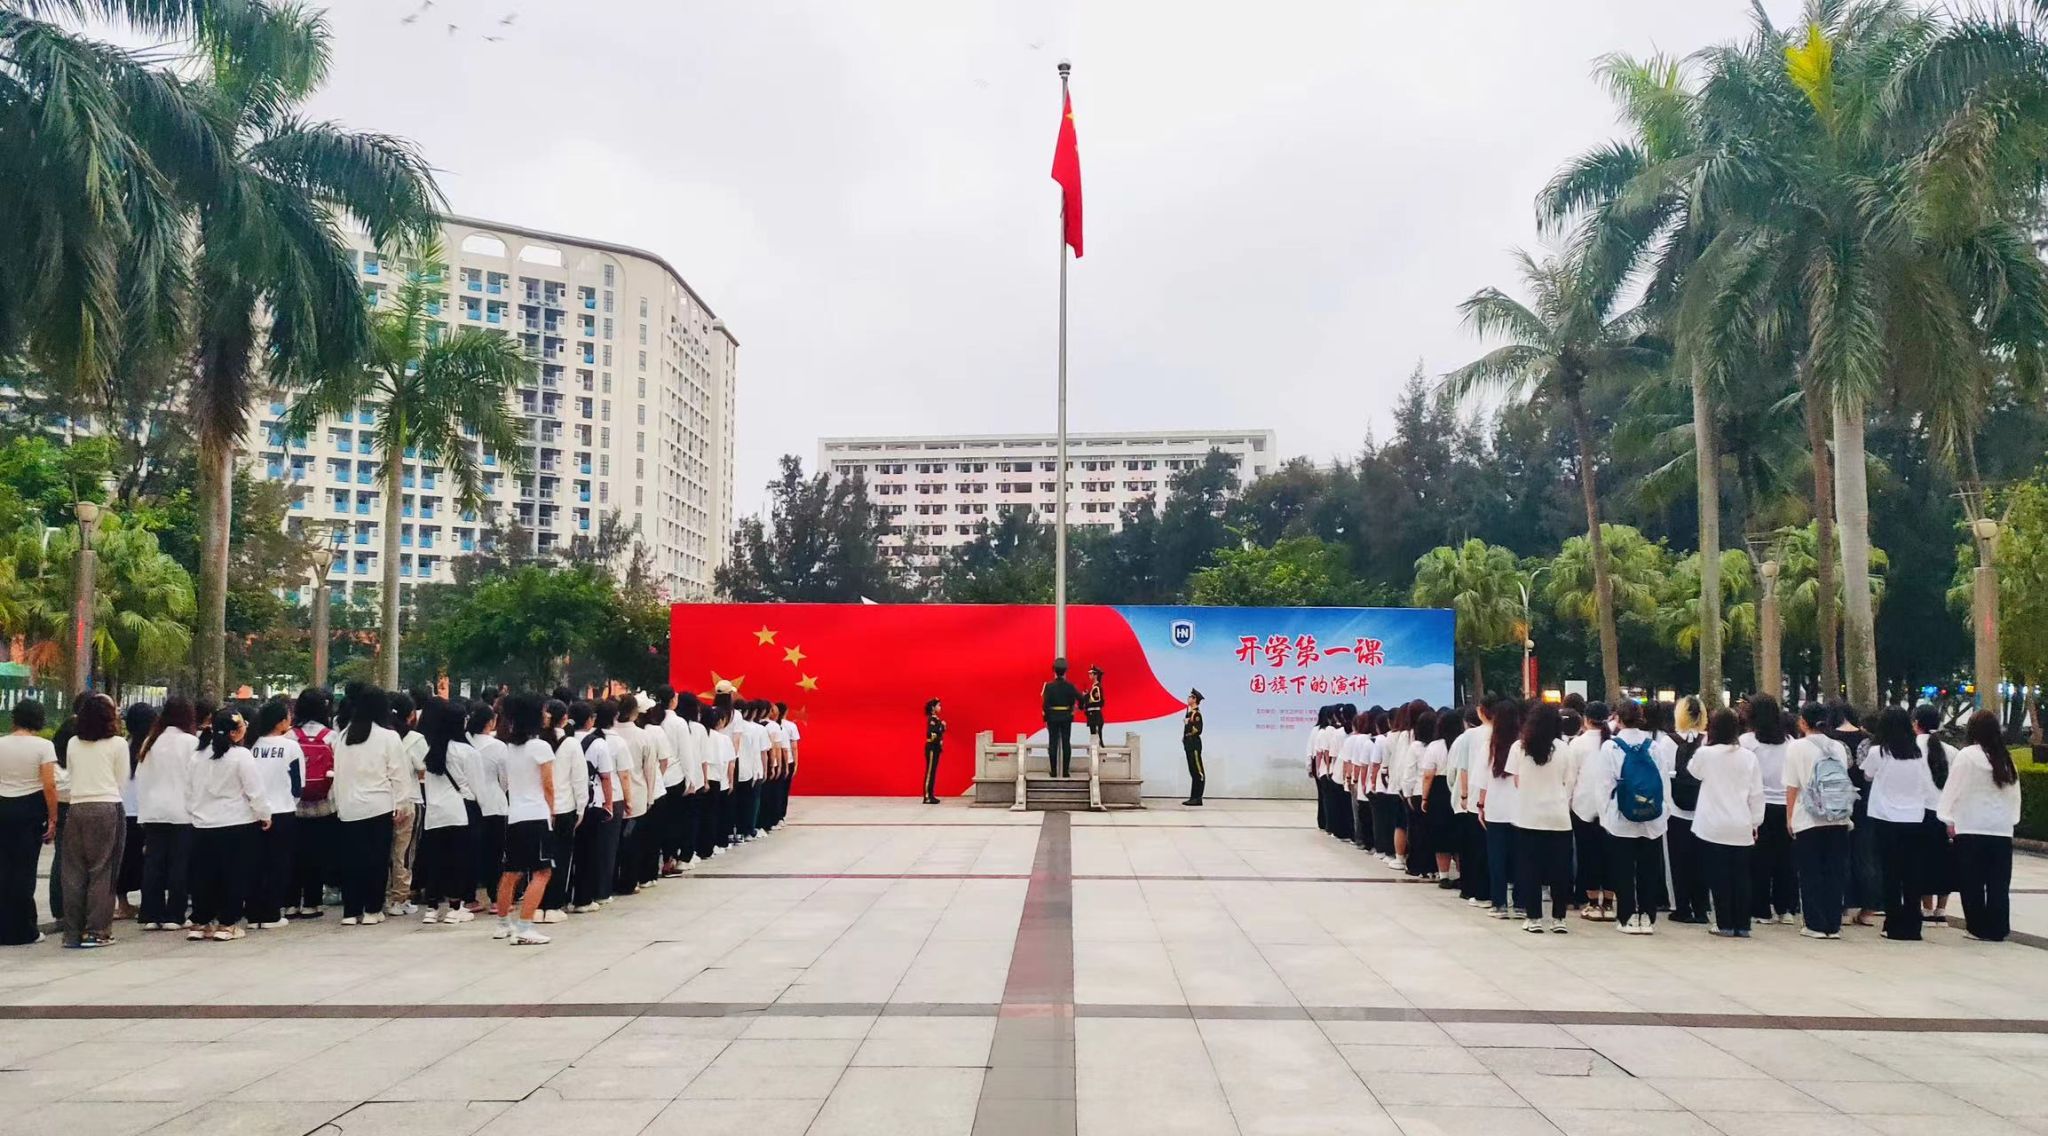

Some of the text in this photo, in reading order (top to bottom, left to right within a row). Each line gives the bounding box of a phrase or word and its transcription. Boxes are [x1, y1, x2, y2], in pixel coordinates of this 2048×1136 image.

[1235, 634, 1384, 668] 开学第一课
[1249, 674, 1370, 697] 国旗下的演讲
